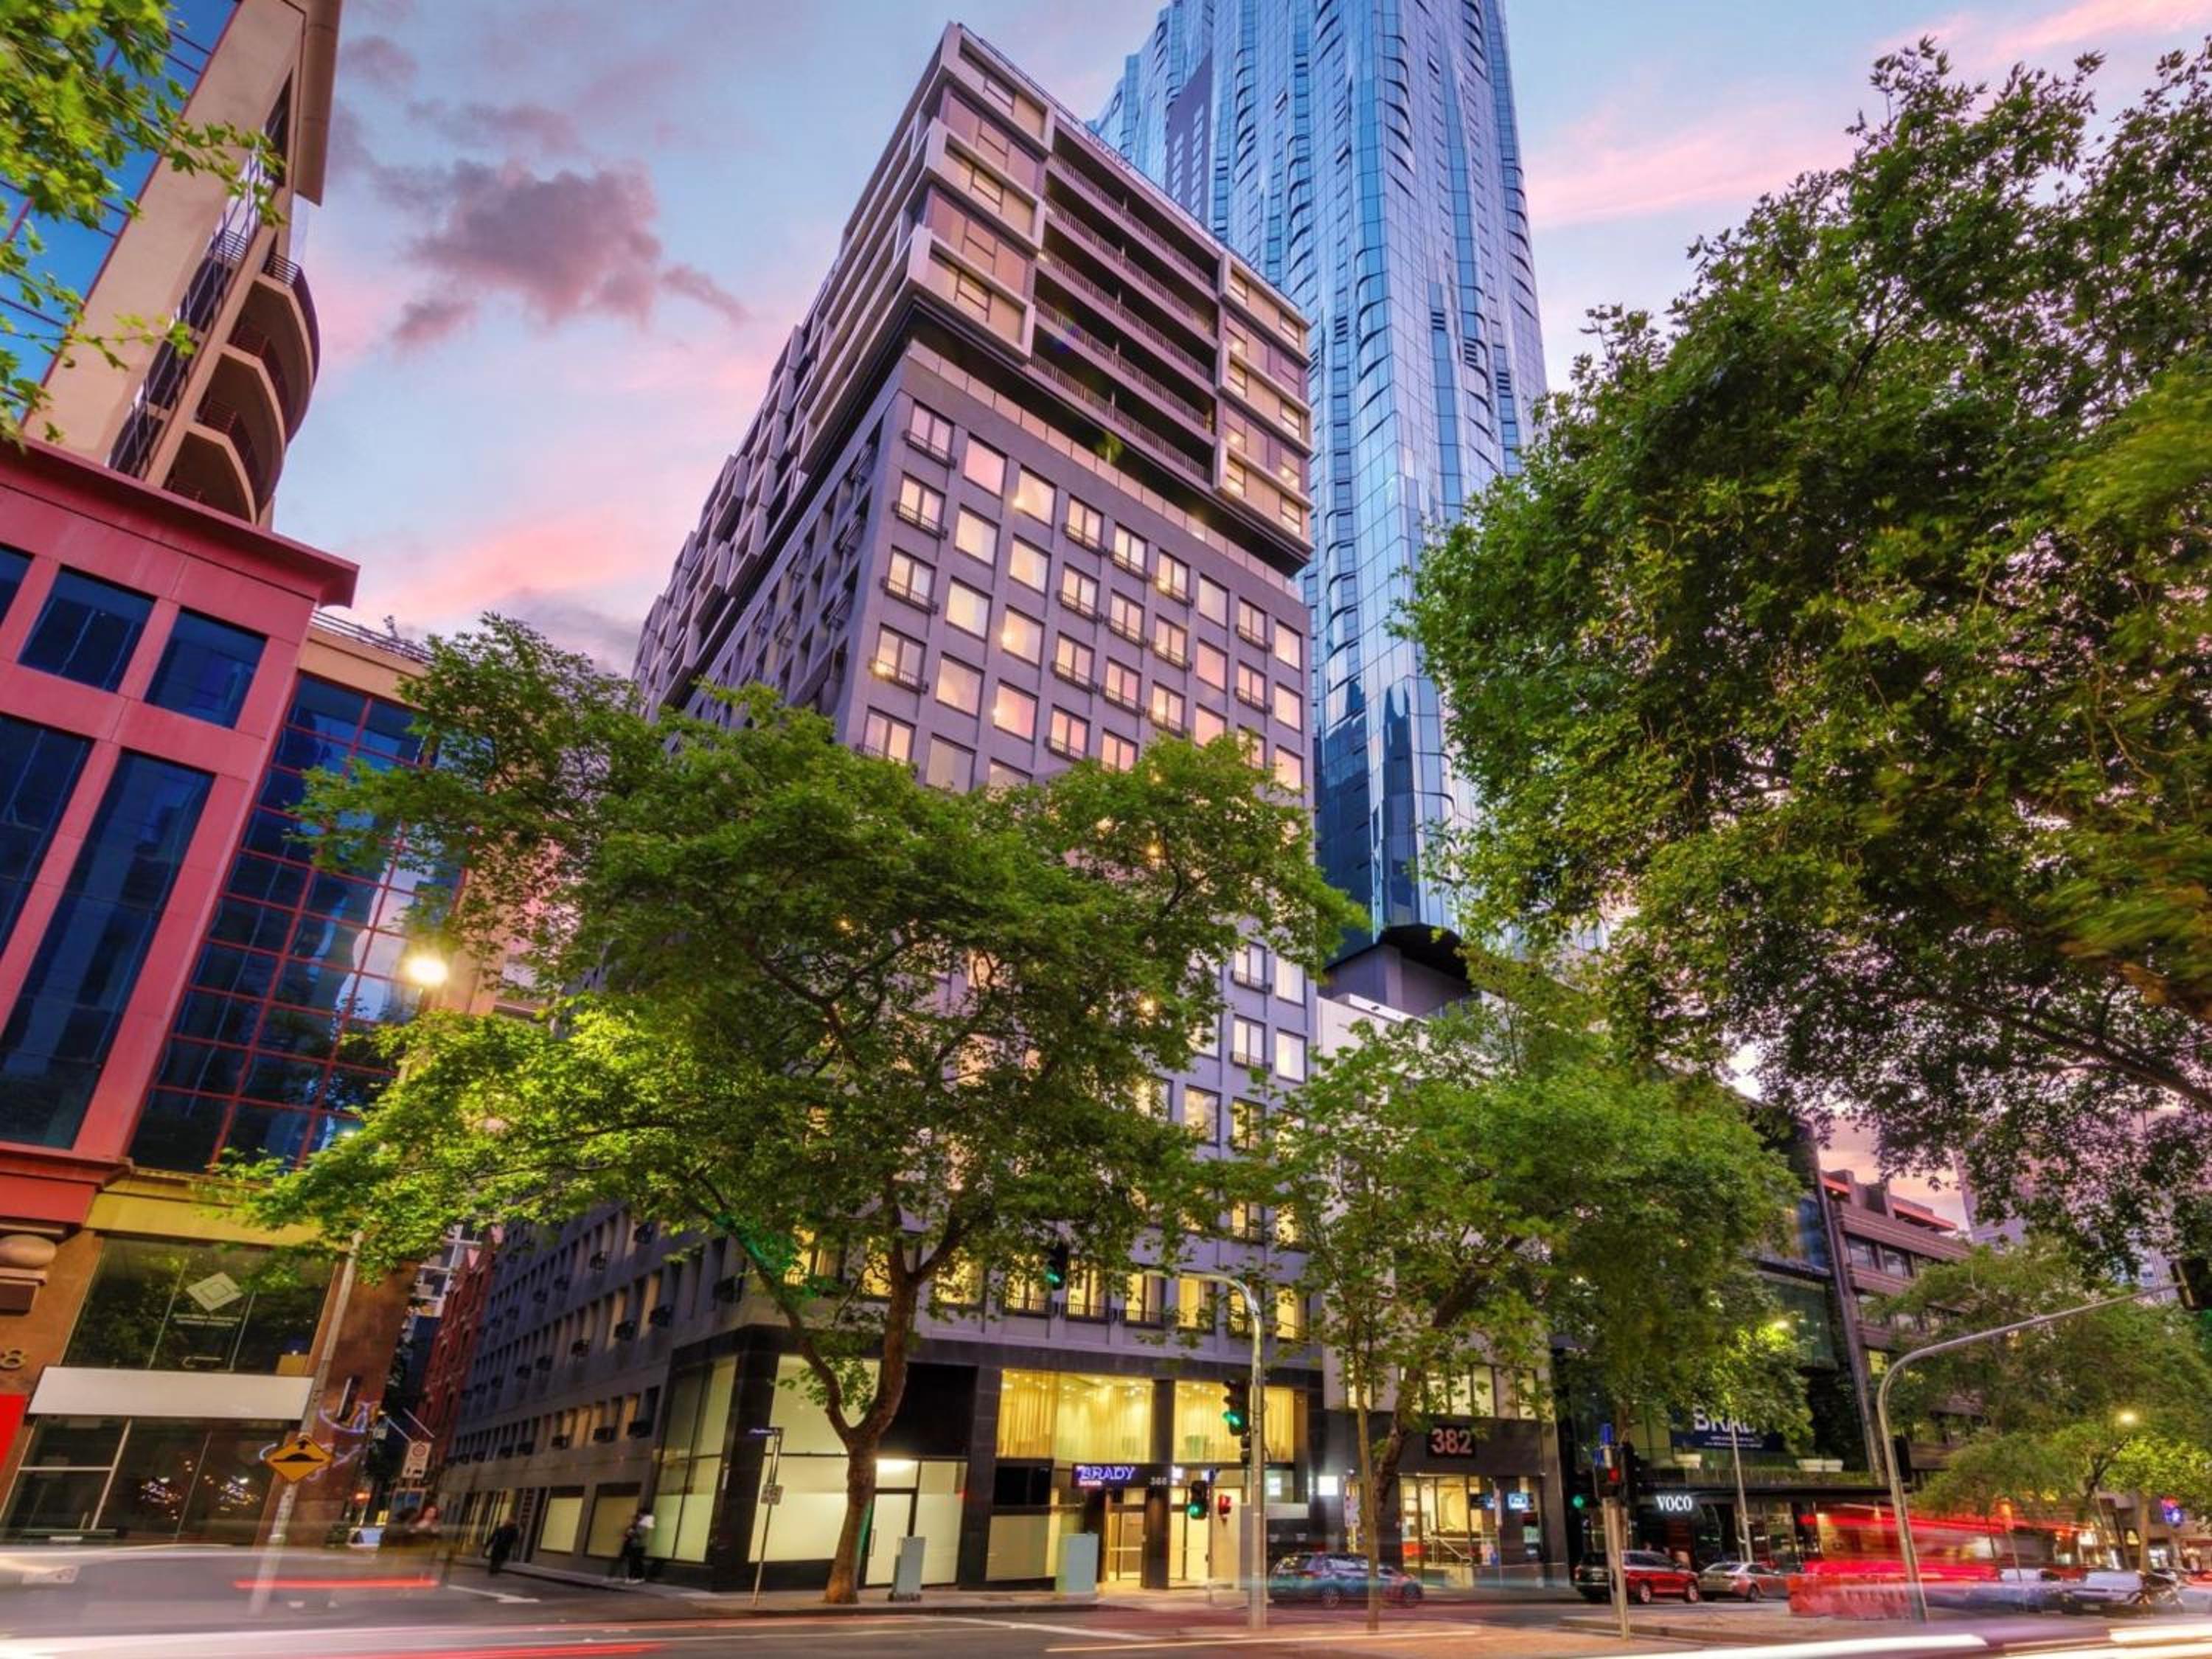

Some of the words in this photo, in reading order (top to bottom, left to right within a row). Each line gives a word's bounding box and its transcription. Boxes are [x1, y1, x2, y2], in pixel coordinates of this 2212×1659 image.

[1431, 1427, 1473, 1454] 382
[1080, 1465, 1135, 1481] BRADY
[1655, 1495, 1693, 1512] VOCO
